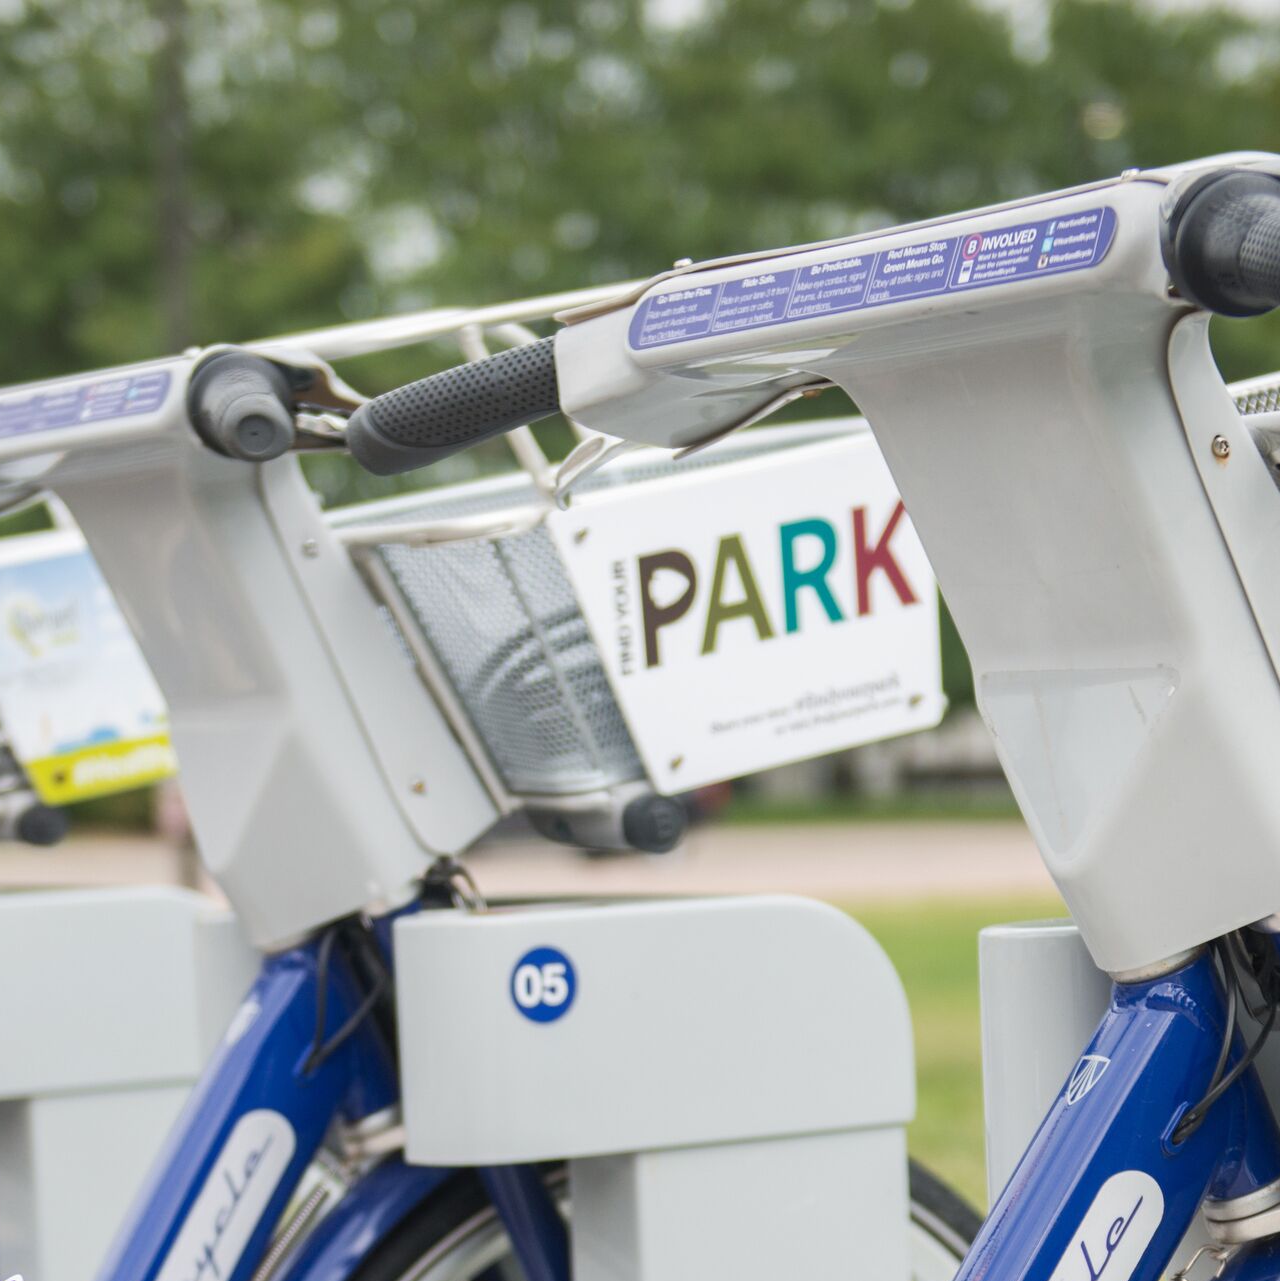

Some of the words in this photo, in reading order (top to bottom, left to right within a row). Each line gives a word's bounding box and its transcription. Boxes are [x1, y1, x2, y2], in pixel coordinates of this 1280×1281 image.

[981, 228, 1037, 252] INVOLVED
[888, 249, 903, 260] Red
[904, 245, 928, 257] Means
[883, 262, 905, 274] Green
[906, 258, 931, 270] Means
[637, 498, 919, 668] PARK
[514, 963, 569, 1008] 05
